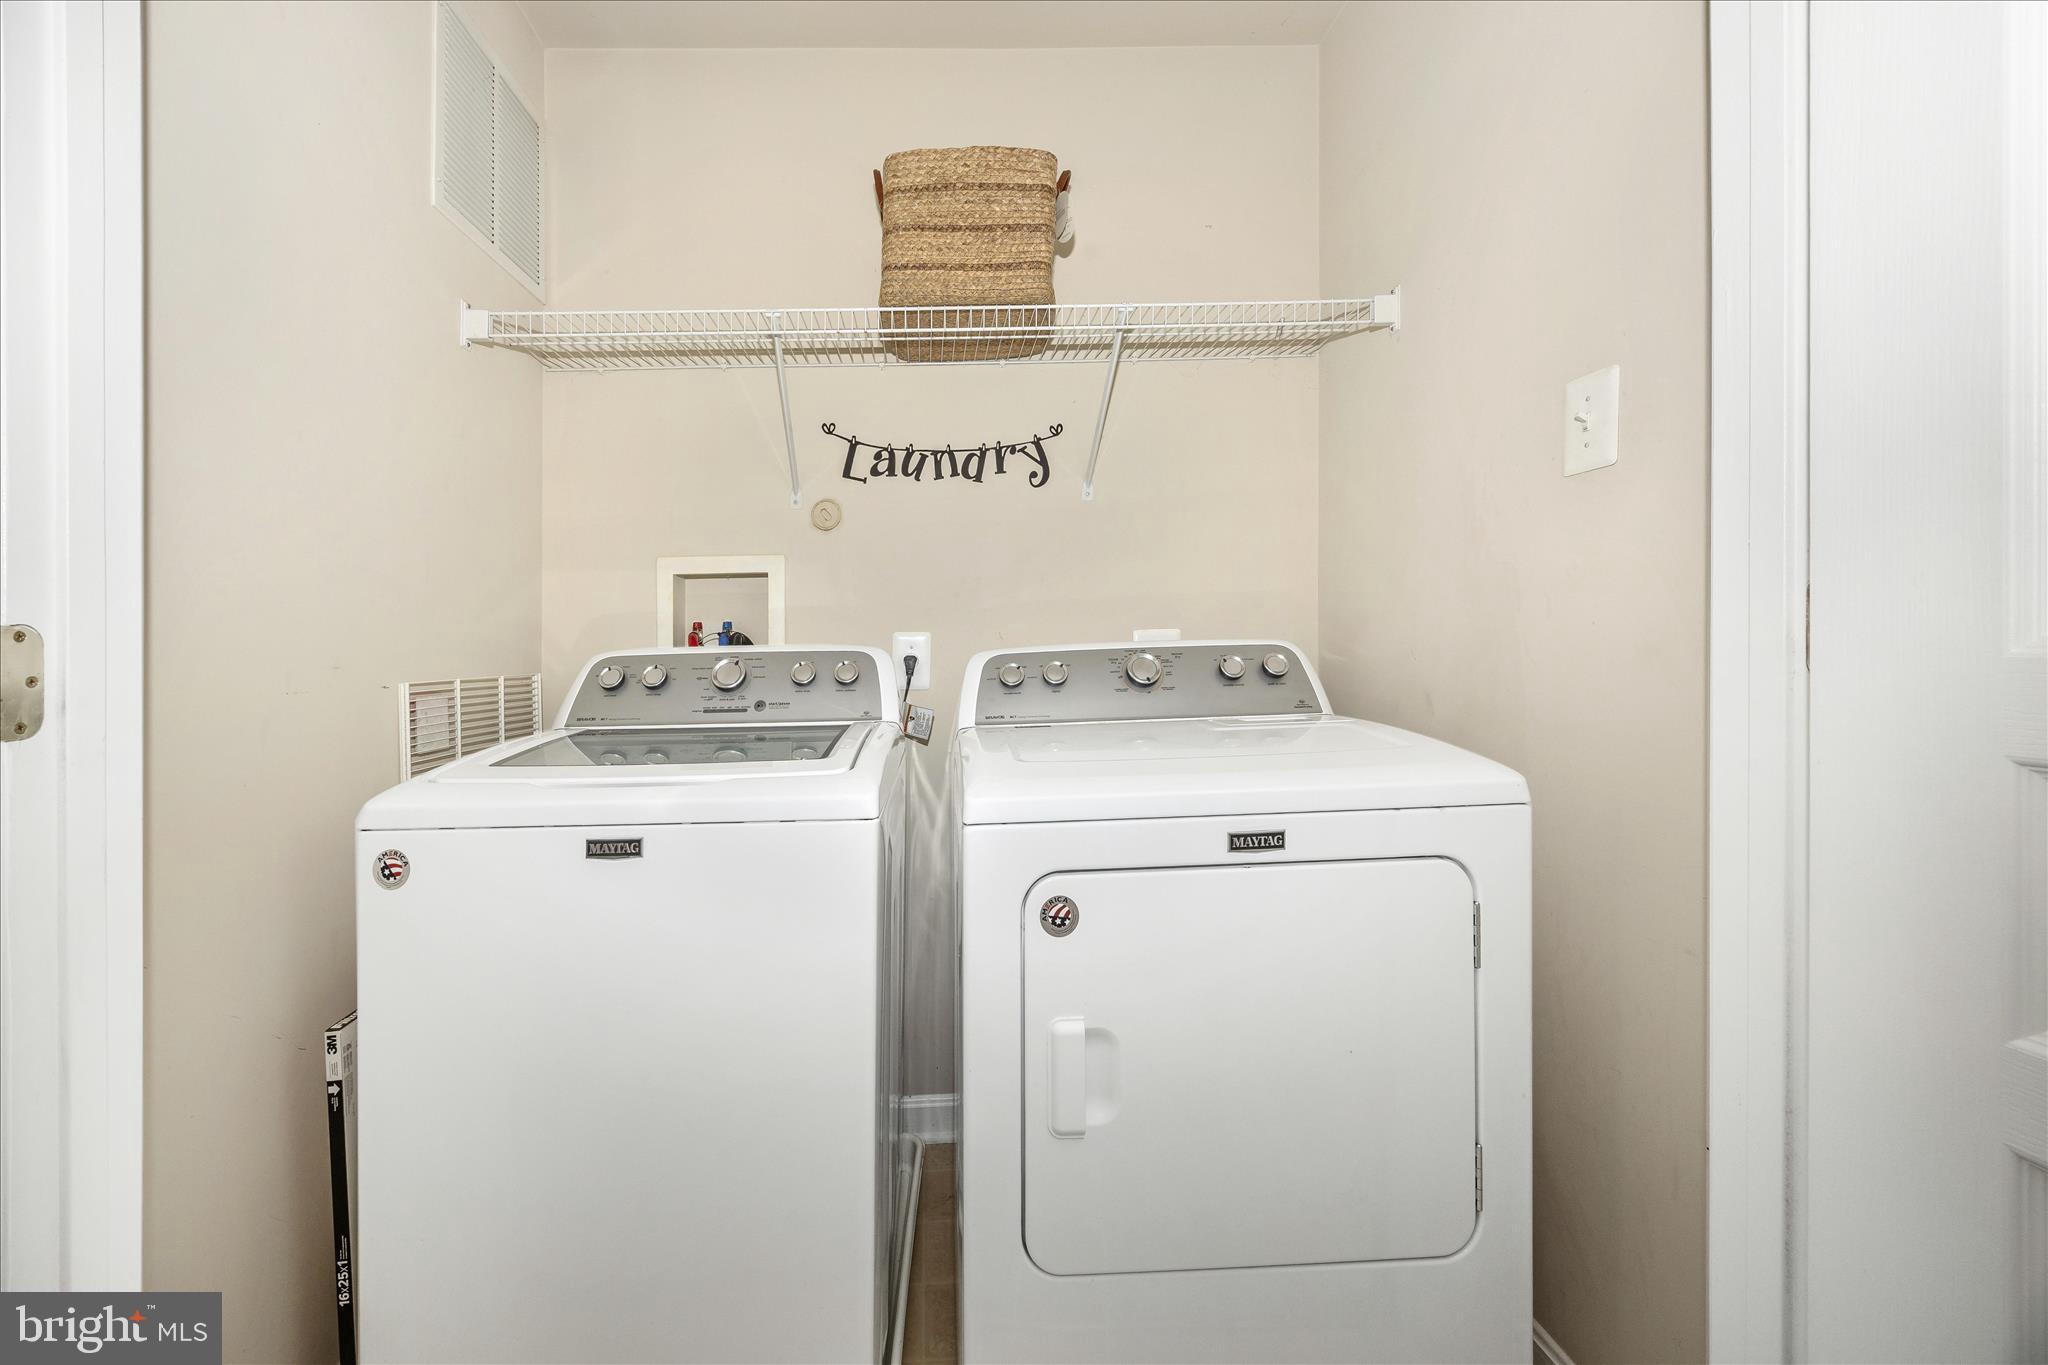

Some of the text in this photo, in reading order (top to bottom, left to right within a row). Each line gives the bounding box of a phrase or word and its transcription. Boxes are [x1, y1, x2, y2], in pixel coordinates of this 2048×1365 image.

[842, 438, 1050, 488] Laundry
[588, 842, 639, 855] MAYTAG
[1231, 835, 1283, 848] MAYTAG
[377, 850, 409, 867] AMERICA
[1041, 896, 1069, 922] AMERICA
[326, 1034, 338, 1055] 3M
[337, 1260, 350, 1307] 16x25x1
